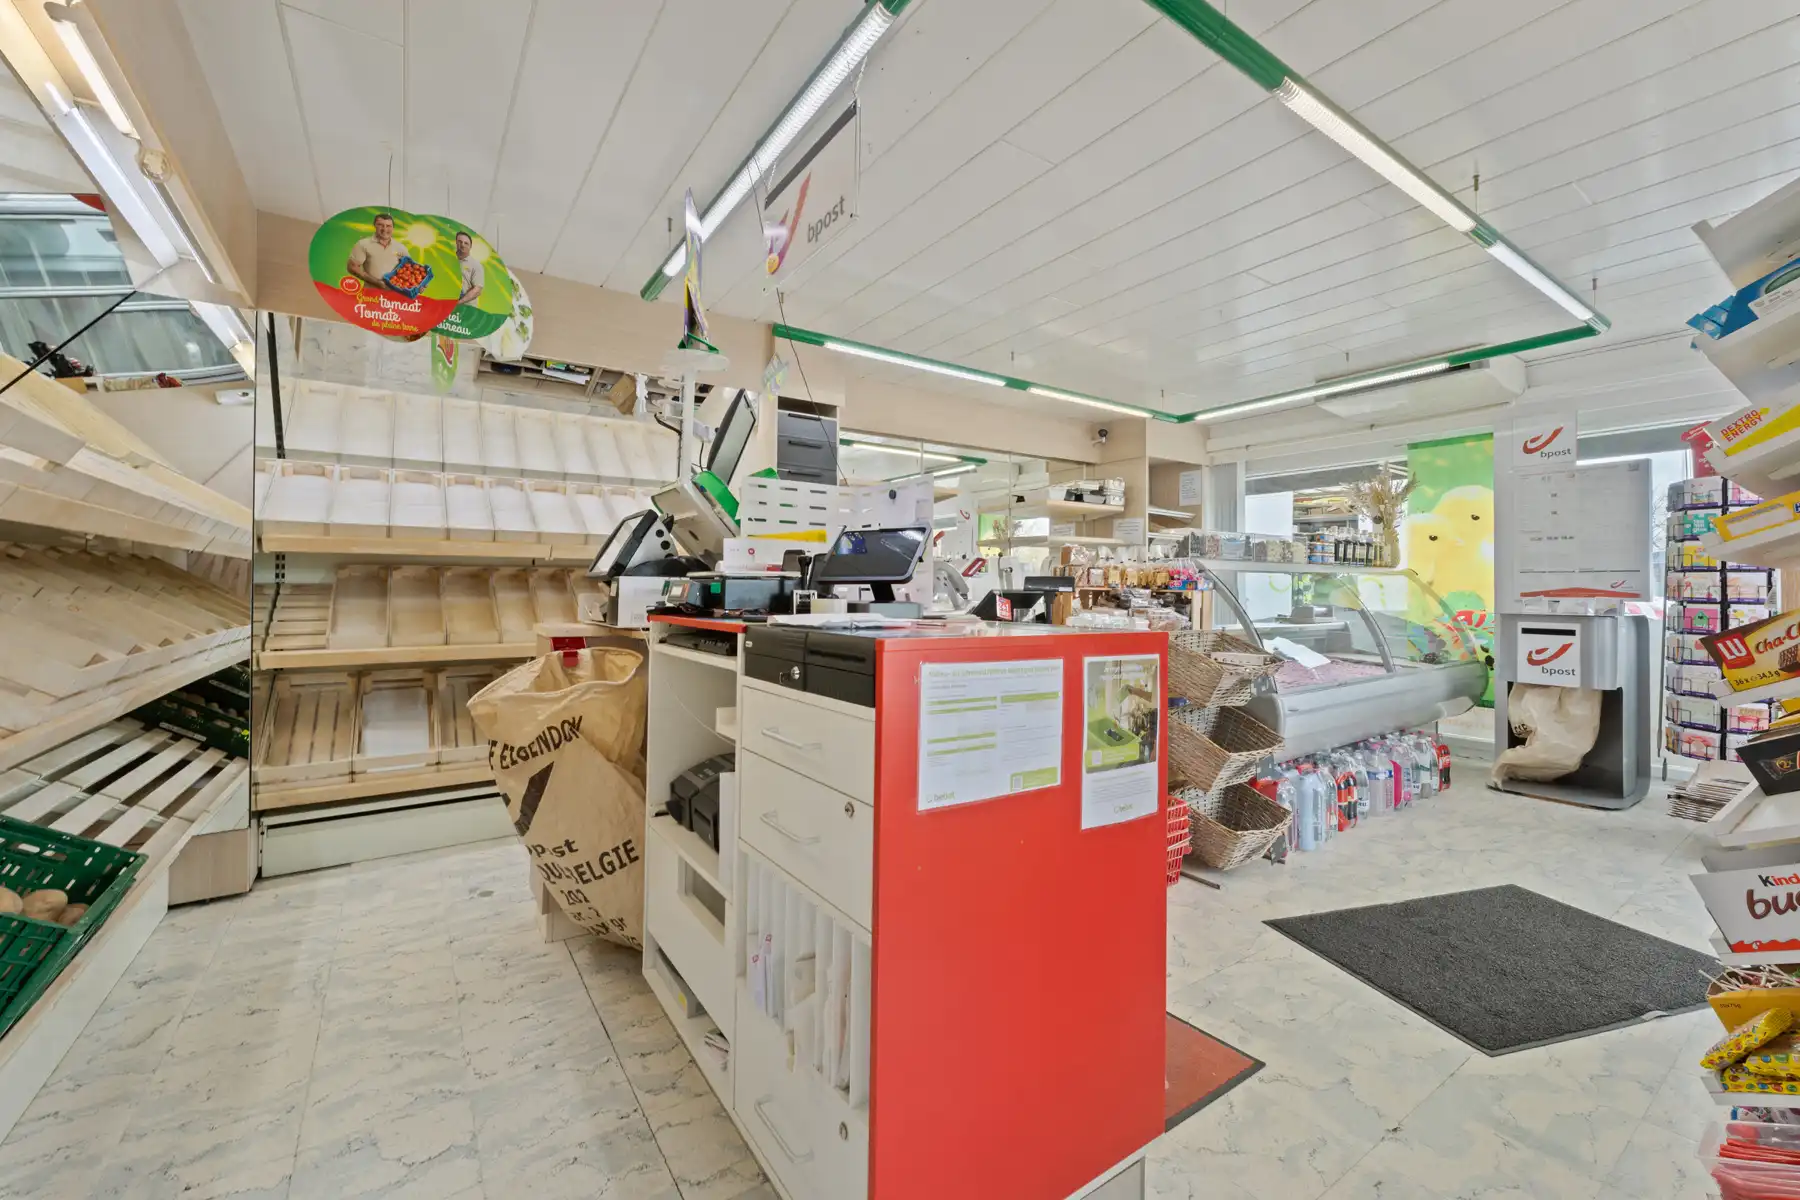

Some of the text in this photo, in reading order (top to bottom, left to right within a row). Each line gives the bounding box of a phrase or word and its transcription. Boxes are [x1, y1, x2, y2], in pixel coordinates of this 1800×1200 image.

[807, 195, 845, 243] bpost
[354, 304, 401, 322] Tomate
[1720, 409, 1759, 436] DEXTRO
[1725, 414, 1764, 443] ENERGY
[1540, 447, 1572, 459] bpost
[1716, 638, 1748, 660] LU
[1541, 665, 1576, 677] bpost
